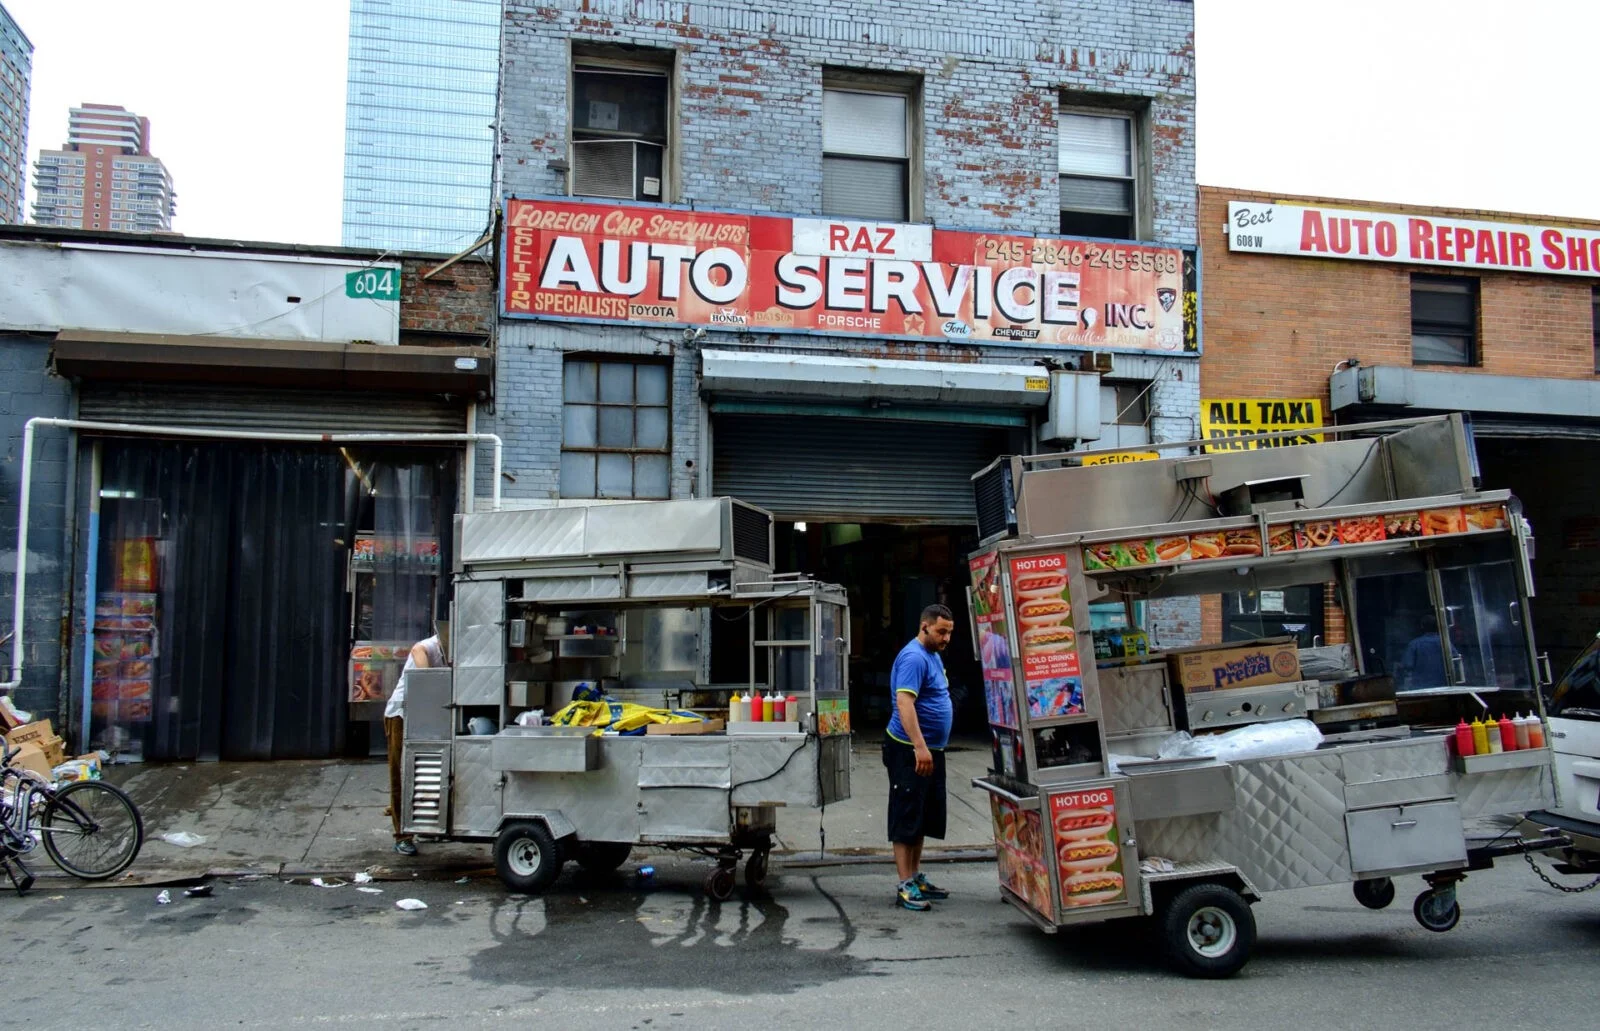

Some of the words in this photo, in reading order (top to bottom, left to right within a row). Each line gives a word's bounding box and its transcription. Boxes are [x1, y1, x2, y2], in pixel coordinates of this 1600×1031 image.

[511, 204, 601, 233] FOREIGN
[603, 210, 642, 237] CAR
[645, 214, 747, 242] SPECIALISTS
[1234, 208, 1273, 228] Best
[830, 225, 896, 255] RAZ
[1299, 209, 1397, 257] AUTO
[1408, 218, 1532, 268] REPAIR
[985, 239, 1083, 266] 245-2846
[510, 227, 533, 309] COLLISION
[355, 270, 394, 295] 604
[539, 235, 748, 305] AUTO
[1104, 303, 1154, 330] INC.
[535, 292, 628, 318] SPECIALISTS
[629, 304, 676, 318] TOYOTA
[711, 314, 745, 324] HONDA
[818, 313, 881, 329] PORSCHE
[943, 320, 968, 335] Ford
[994, 328, 1038, 339] CHEVROLET
[1209, 402, 1251, 424] ALL
[1257, 402, 1315, 424] TAXI
[1016, 560, 1037, 571] HOT
[1039, 557, 1061, 568] DOG
[1026, 656, 1047, 664] COLD
[1212, 655, 1273, 688] Pretzel
[1056, 795, 1080, 807] HOT
[1083, 792, 1108, 804] DOG
